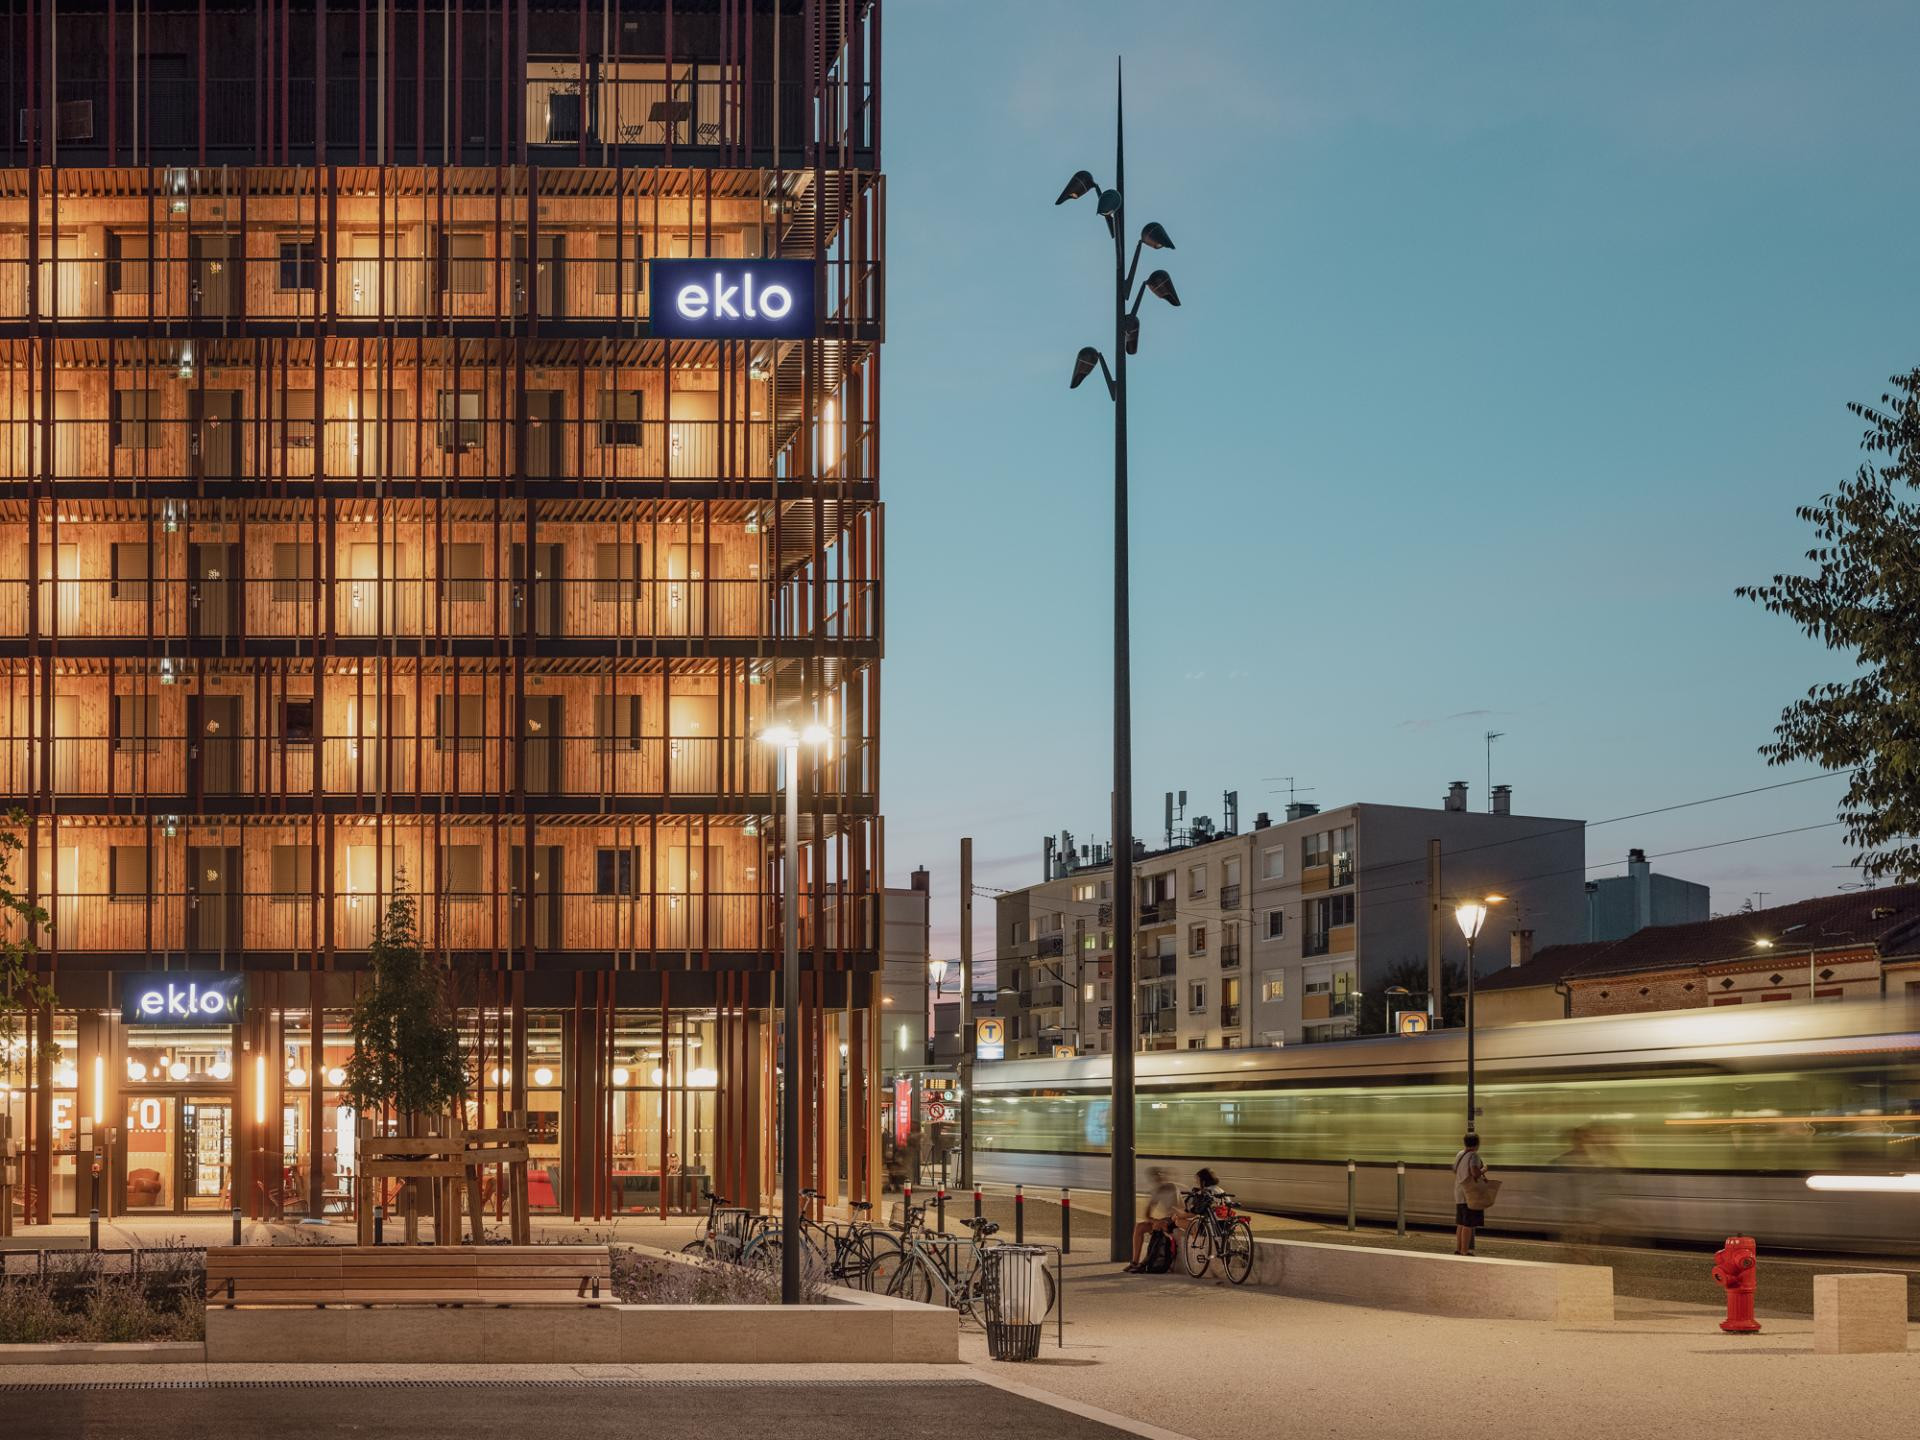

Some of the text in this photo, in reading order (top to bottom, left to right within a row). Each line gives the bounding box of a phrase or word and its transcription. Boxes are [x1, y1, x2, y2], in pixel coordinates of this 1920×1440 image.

[677, 271, 793, 319] eklo
[141, 983, 224, 1014] eklo
[985, 1025, 996, 1039] T
[1408, 1019, 1420, 1032] T
